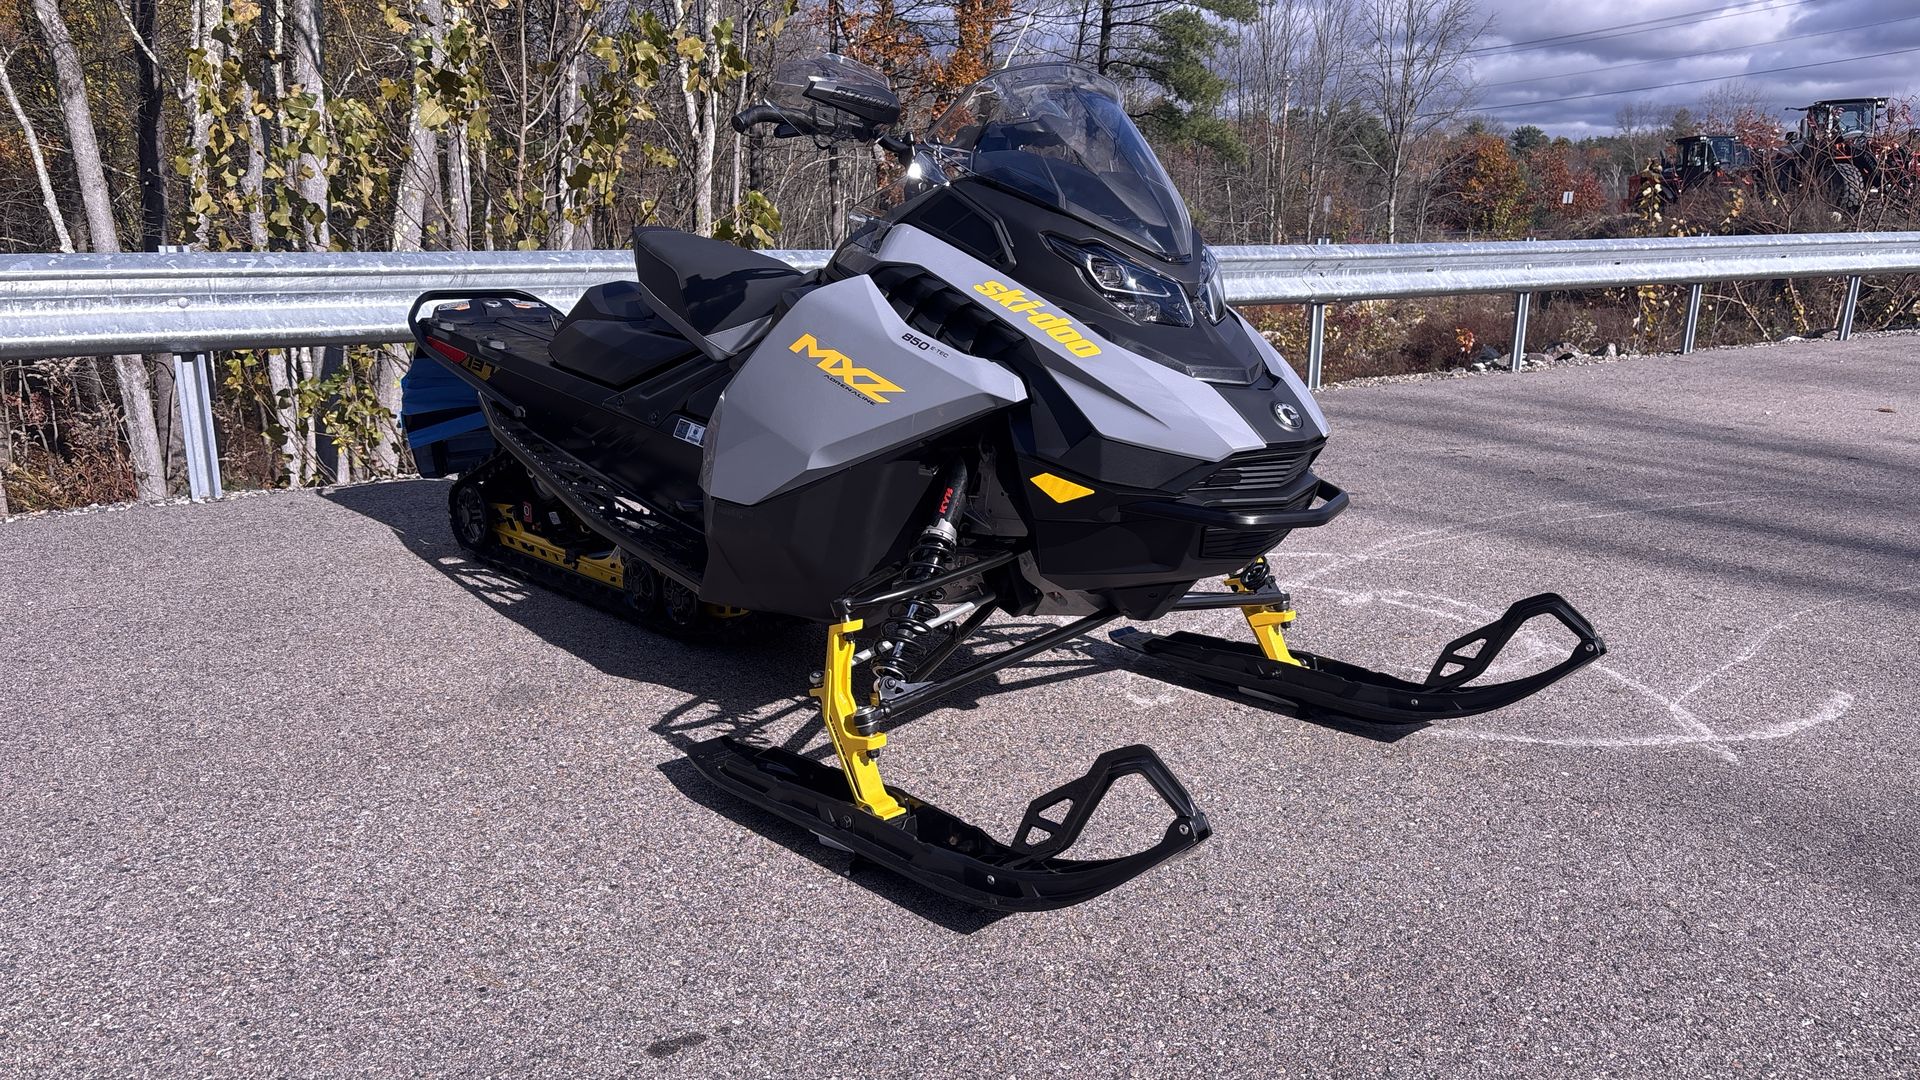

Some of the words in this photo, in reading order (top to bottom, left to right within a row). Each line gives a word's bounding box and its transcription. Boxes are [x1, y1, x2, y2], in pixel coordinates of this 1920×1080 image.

[973, 280, 1102, 358] ski-doo
[788, 332, 907, 403] MXZ
[901, 333, 930, 351] 850
[930, 346, 950, 359] E-TEC
[823, 374, 877, 407] ADRENALINE
